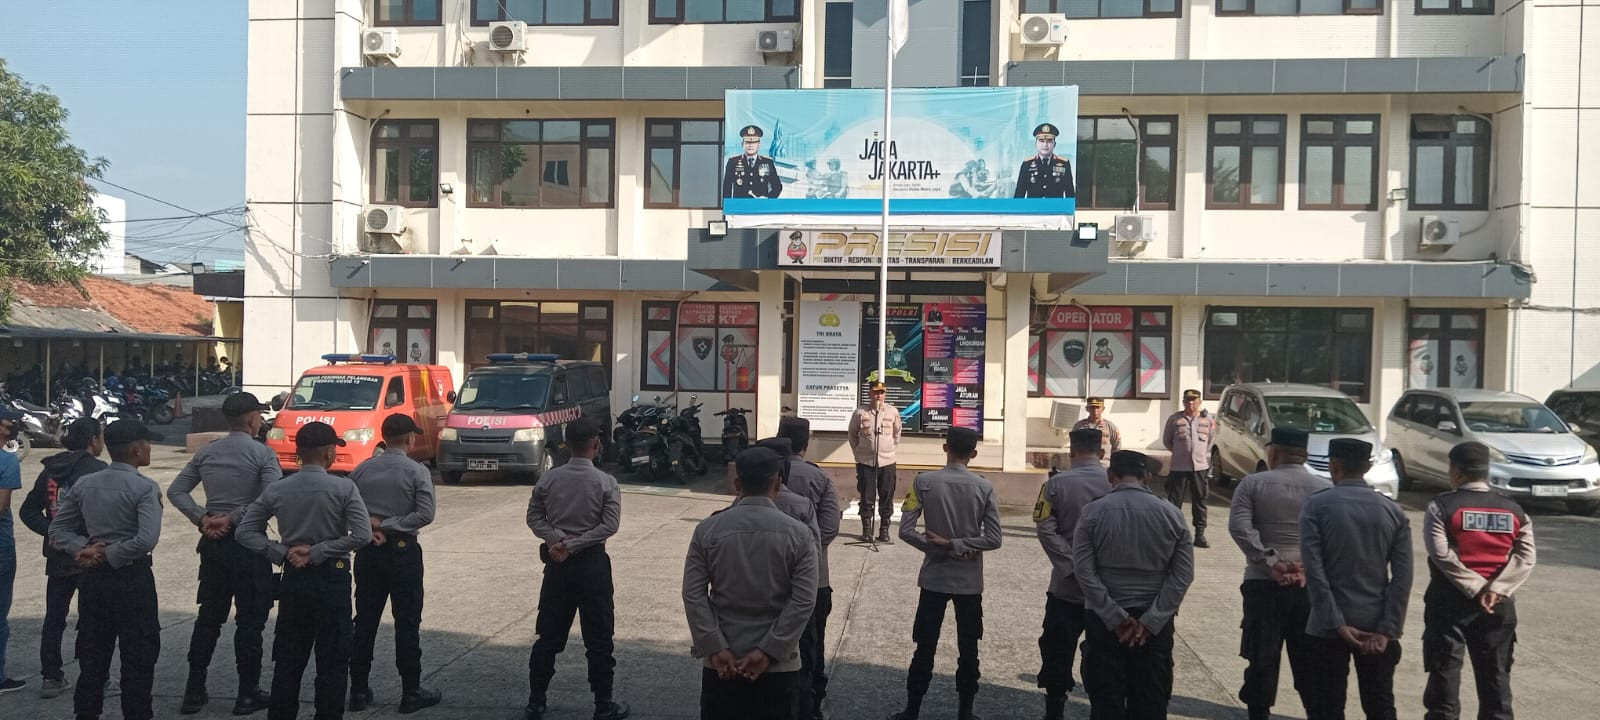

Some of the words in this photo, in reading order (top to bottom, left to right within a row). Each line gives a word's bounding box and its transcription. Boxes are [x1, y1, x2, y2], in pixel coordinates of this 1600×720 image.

[859, 138, 898, 161] JAGA
[813, 232, 993, 256] PRESISI
[952, 257, 994, 265] BERKEADILAN
[698, 315, 738, 324] SPKT
[1057, 311, 1122, 324] OPERATOR
[296, 416, 335, 425] POLISI
[467, 416, 506, 425] POLISI
[1466, 513, 1512, 531] POLISI
